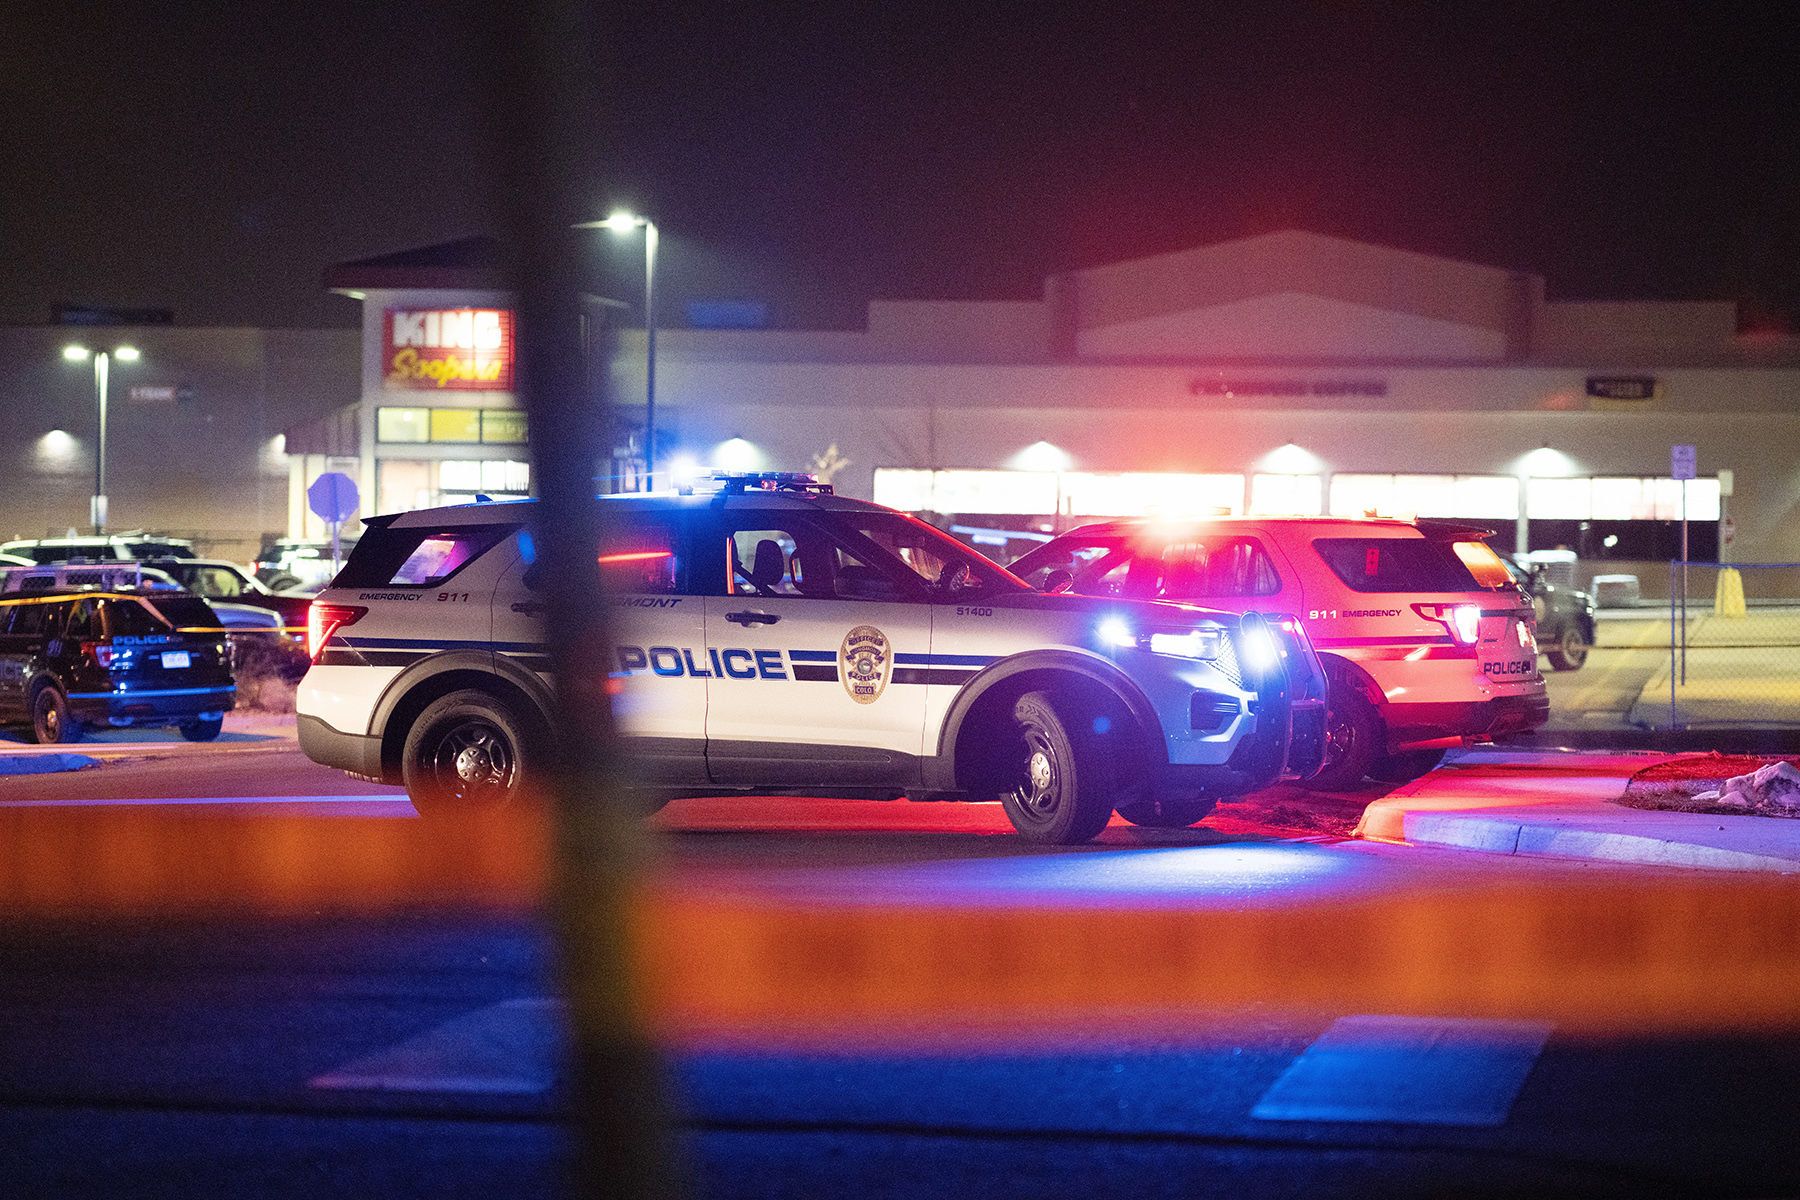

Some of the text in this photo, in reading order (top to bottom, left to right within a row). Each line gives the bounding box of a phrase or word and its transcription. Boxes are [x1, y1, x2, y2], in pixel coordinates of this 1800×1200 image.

[393, 311, 502, 349] KING
[359, 592, 469, 602] EMERGENCY 911
[617, 597, 682, 608] MONT
[956, 606, 993, 617] 51400
[1309, 609, 1402, 620] 911 EMERGENCY
[112, 635, 167, 645] POLICE
[616, 645, 789, 681] POLICE
[1483, 661, 1521, 675] POLICE
